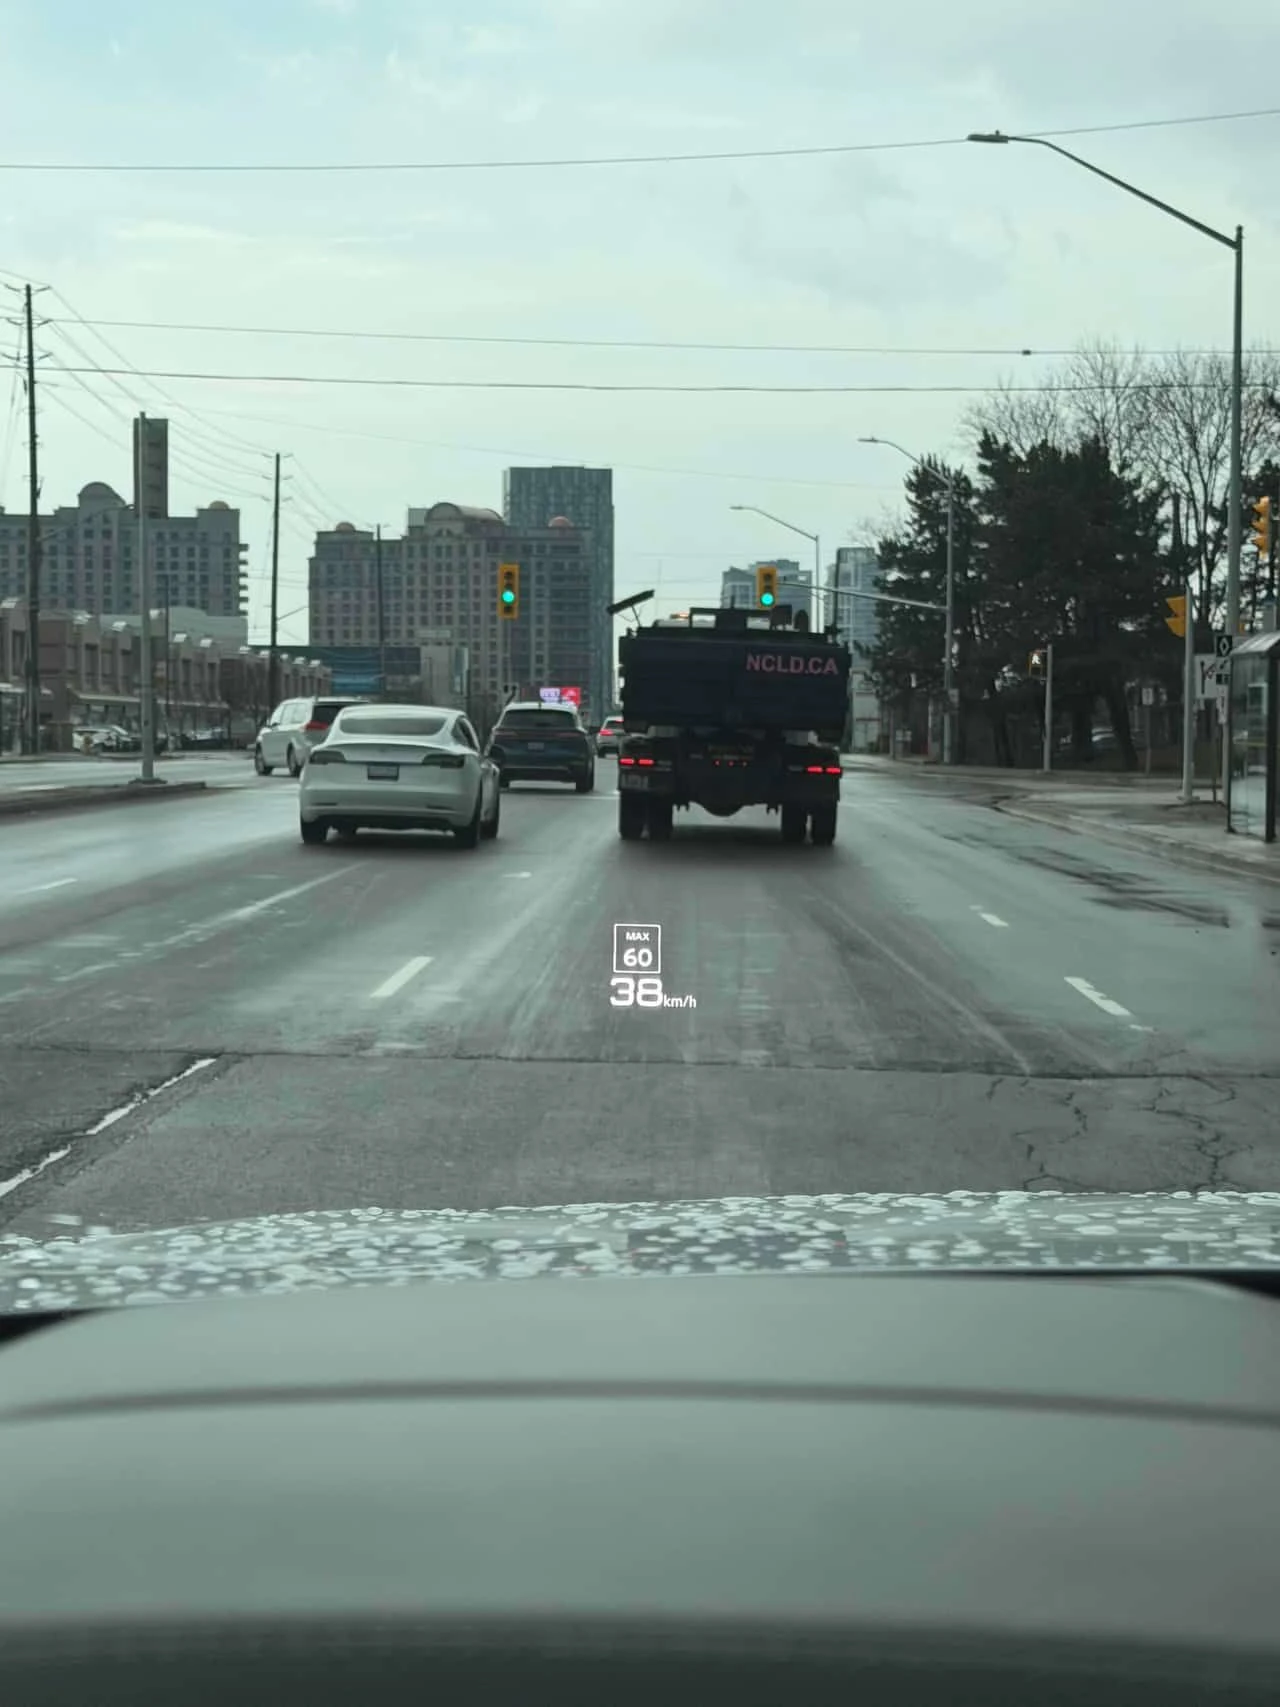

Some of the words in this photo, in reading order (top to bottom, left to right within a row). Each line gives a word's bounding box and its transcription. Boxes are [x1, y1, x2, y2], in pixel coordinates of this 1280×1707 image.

[746, 653, 838, 675] NCLD.CA
[625, 931, 650, 941] MAX
[623, 948, 652, 967] 60
[610, 977, 663, 1007] 38
[663, 994, 697, 1008] km/h
